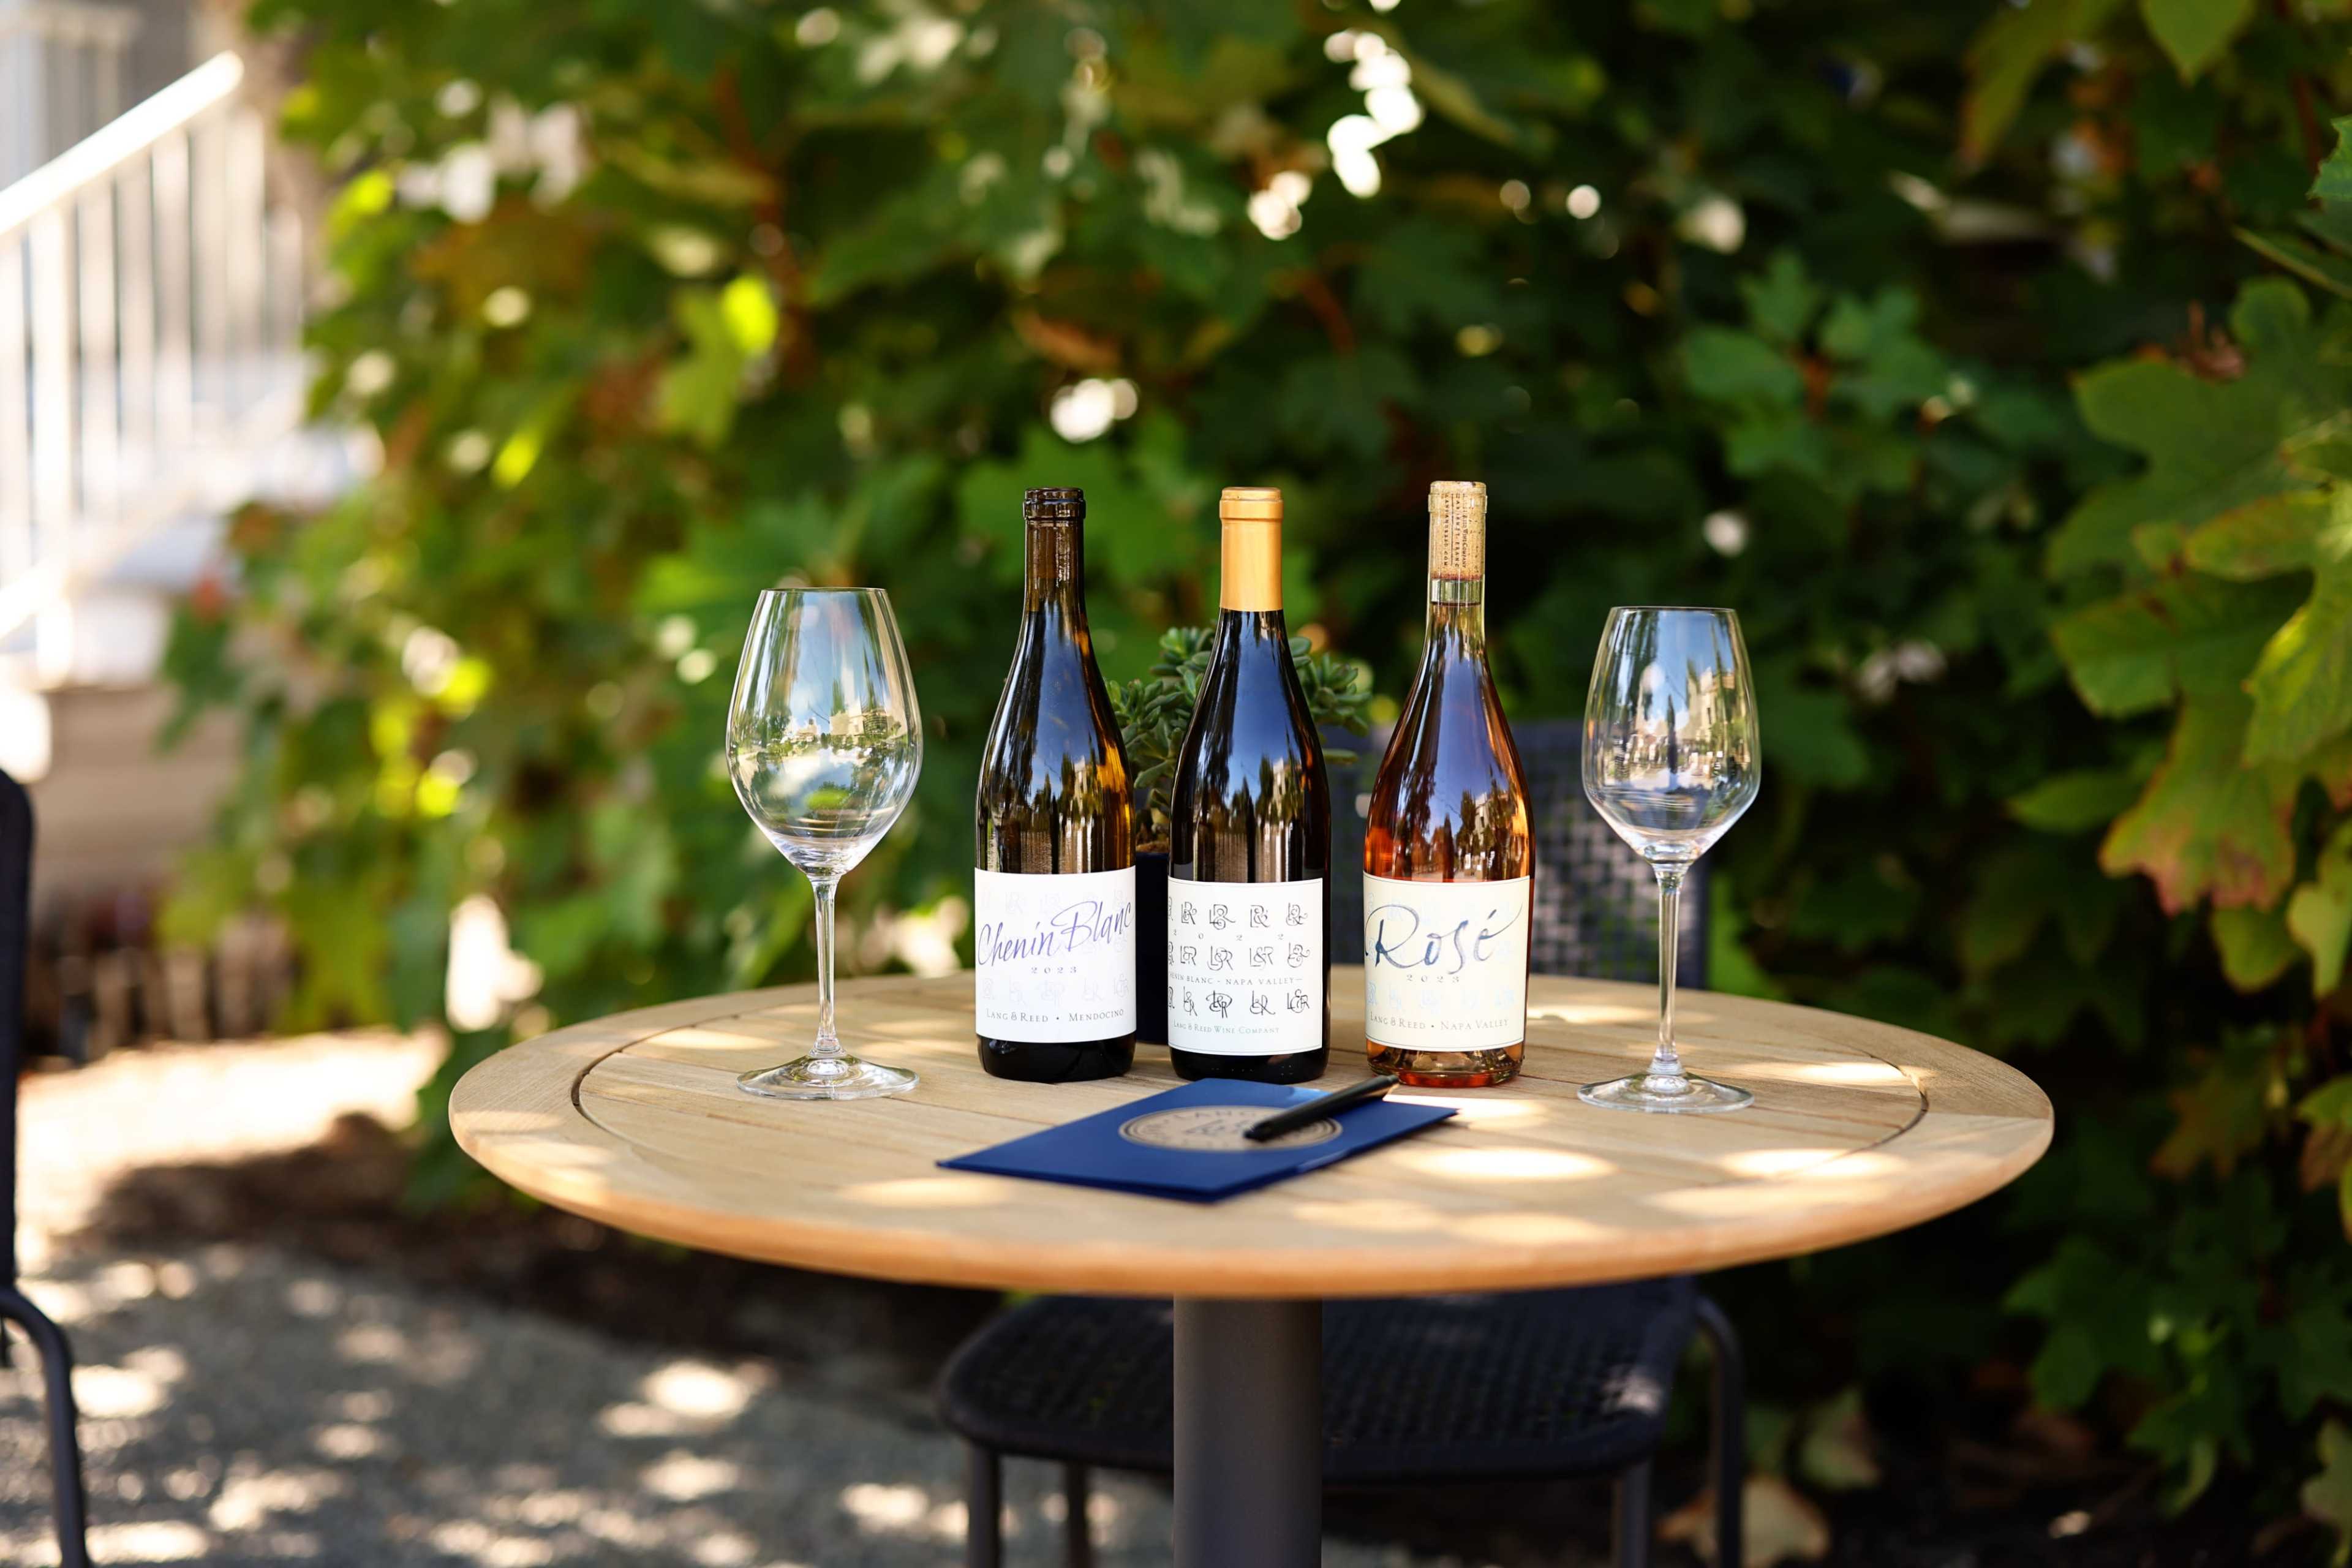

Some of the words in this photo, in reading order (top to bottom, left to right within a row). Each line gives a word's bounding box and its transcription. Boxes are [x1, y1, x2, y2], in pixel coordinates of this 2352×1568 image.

[978, 921, 1060, 967] Chenin
[1050, 901, 1131, 952] Blanc
[1365, 902, 1523, 974] Rosé
[1186, 976, 1214, 985] BLANC
[986, 1008, 1009, 1020] LANG
[1011, 1011, 1017, 1021] &
[1020, 1012, 1049, 1022] REED
[1068, 1009, 1125, 1022] MENDOCINO
[1194, 1024, 1212, 1033] REED
[1214, 1025, 1236, 1034] WINE
[1398, 1018, 1426, 1029] REED
[1440, 1021, 1472, 1030] NAPA
[1475, 1019, 1509, 1030] VALLEY
